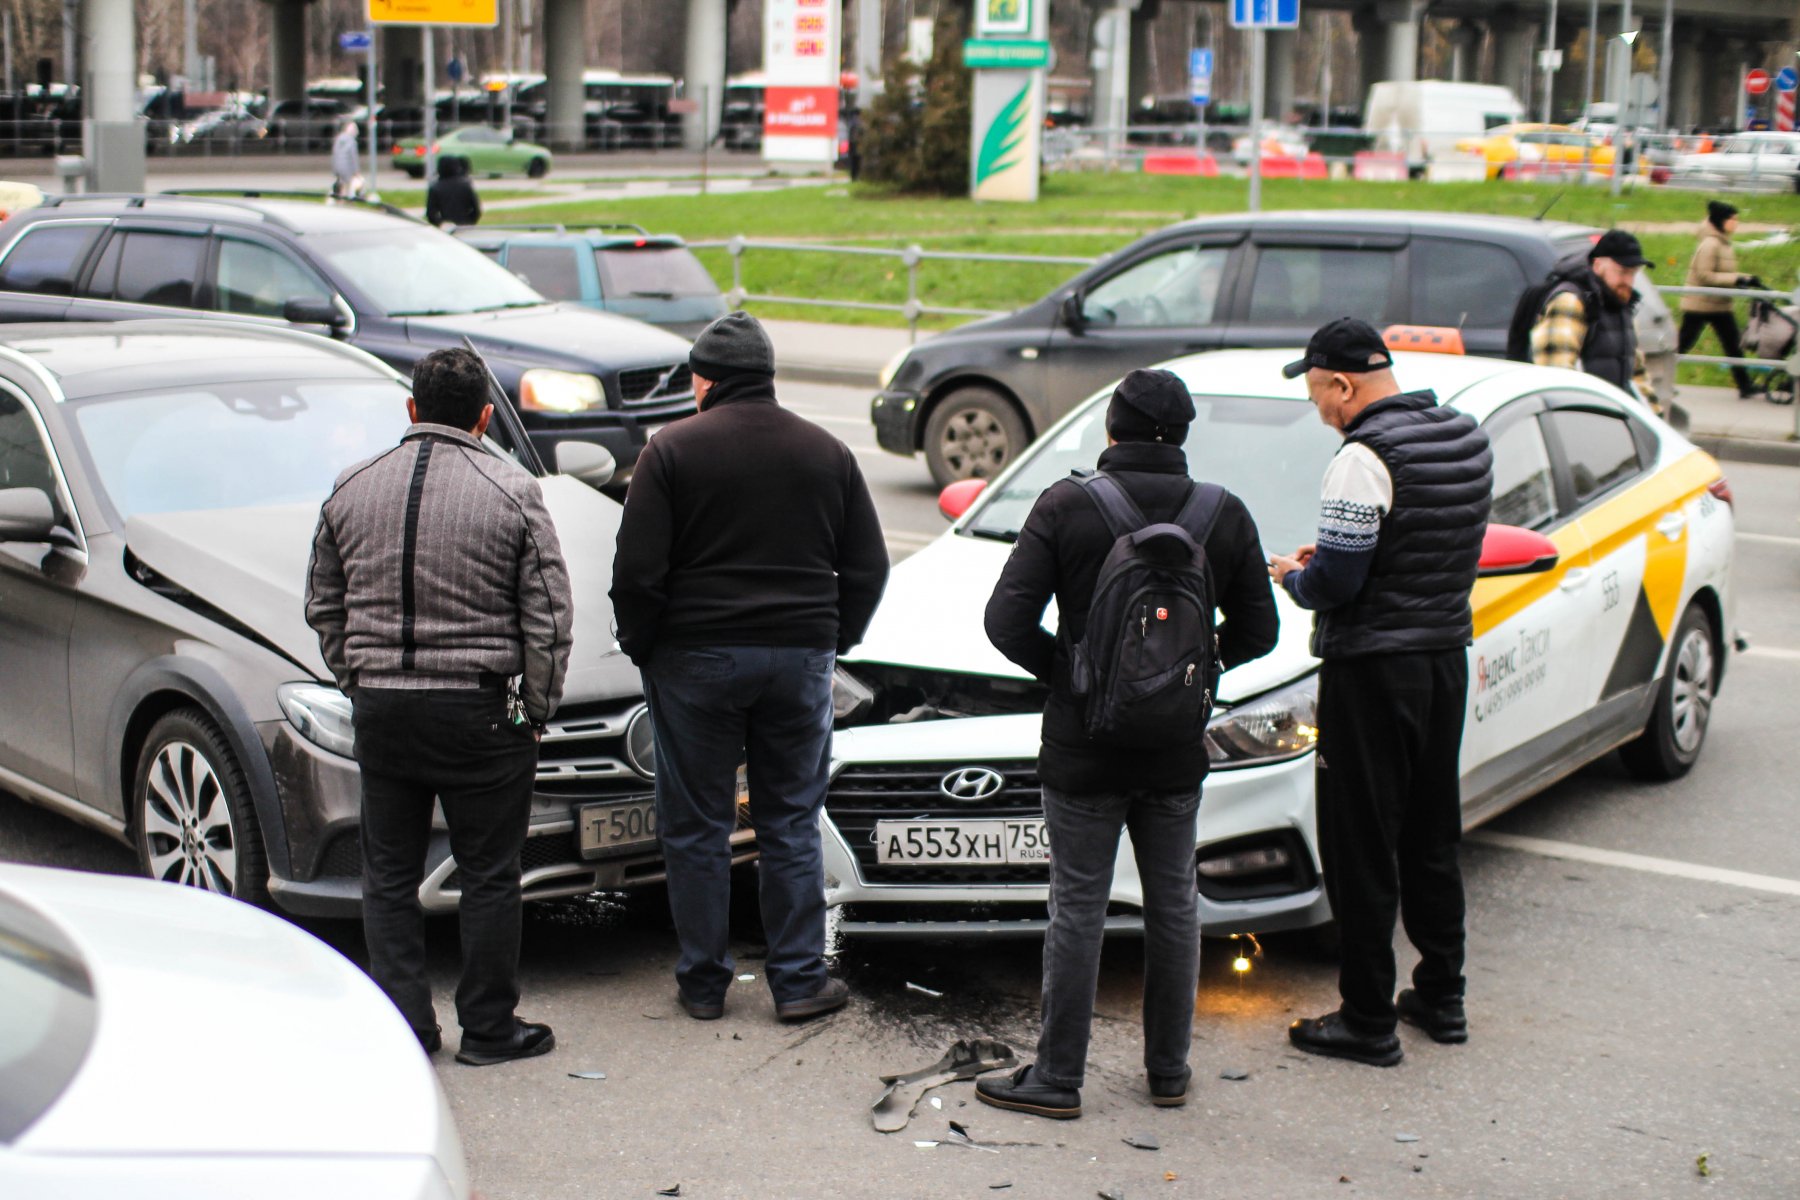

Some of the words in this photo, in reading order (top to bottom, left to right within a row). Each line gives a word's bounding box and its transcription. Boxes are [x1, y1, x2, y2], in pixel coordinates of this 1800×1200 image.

[1476, 647, 1516, 694] Яндекс
[1519, 628, 1550, 666] Такси
[888, 827, 1001, 858] А553ХН
[1007, 824, 1050, 848] 750
[1020, 850, 1043, 859] RUS
